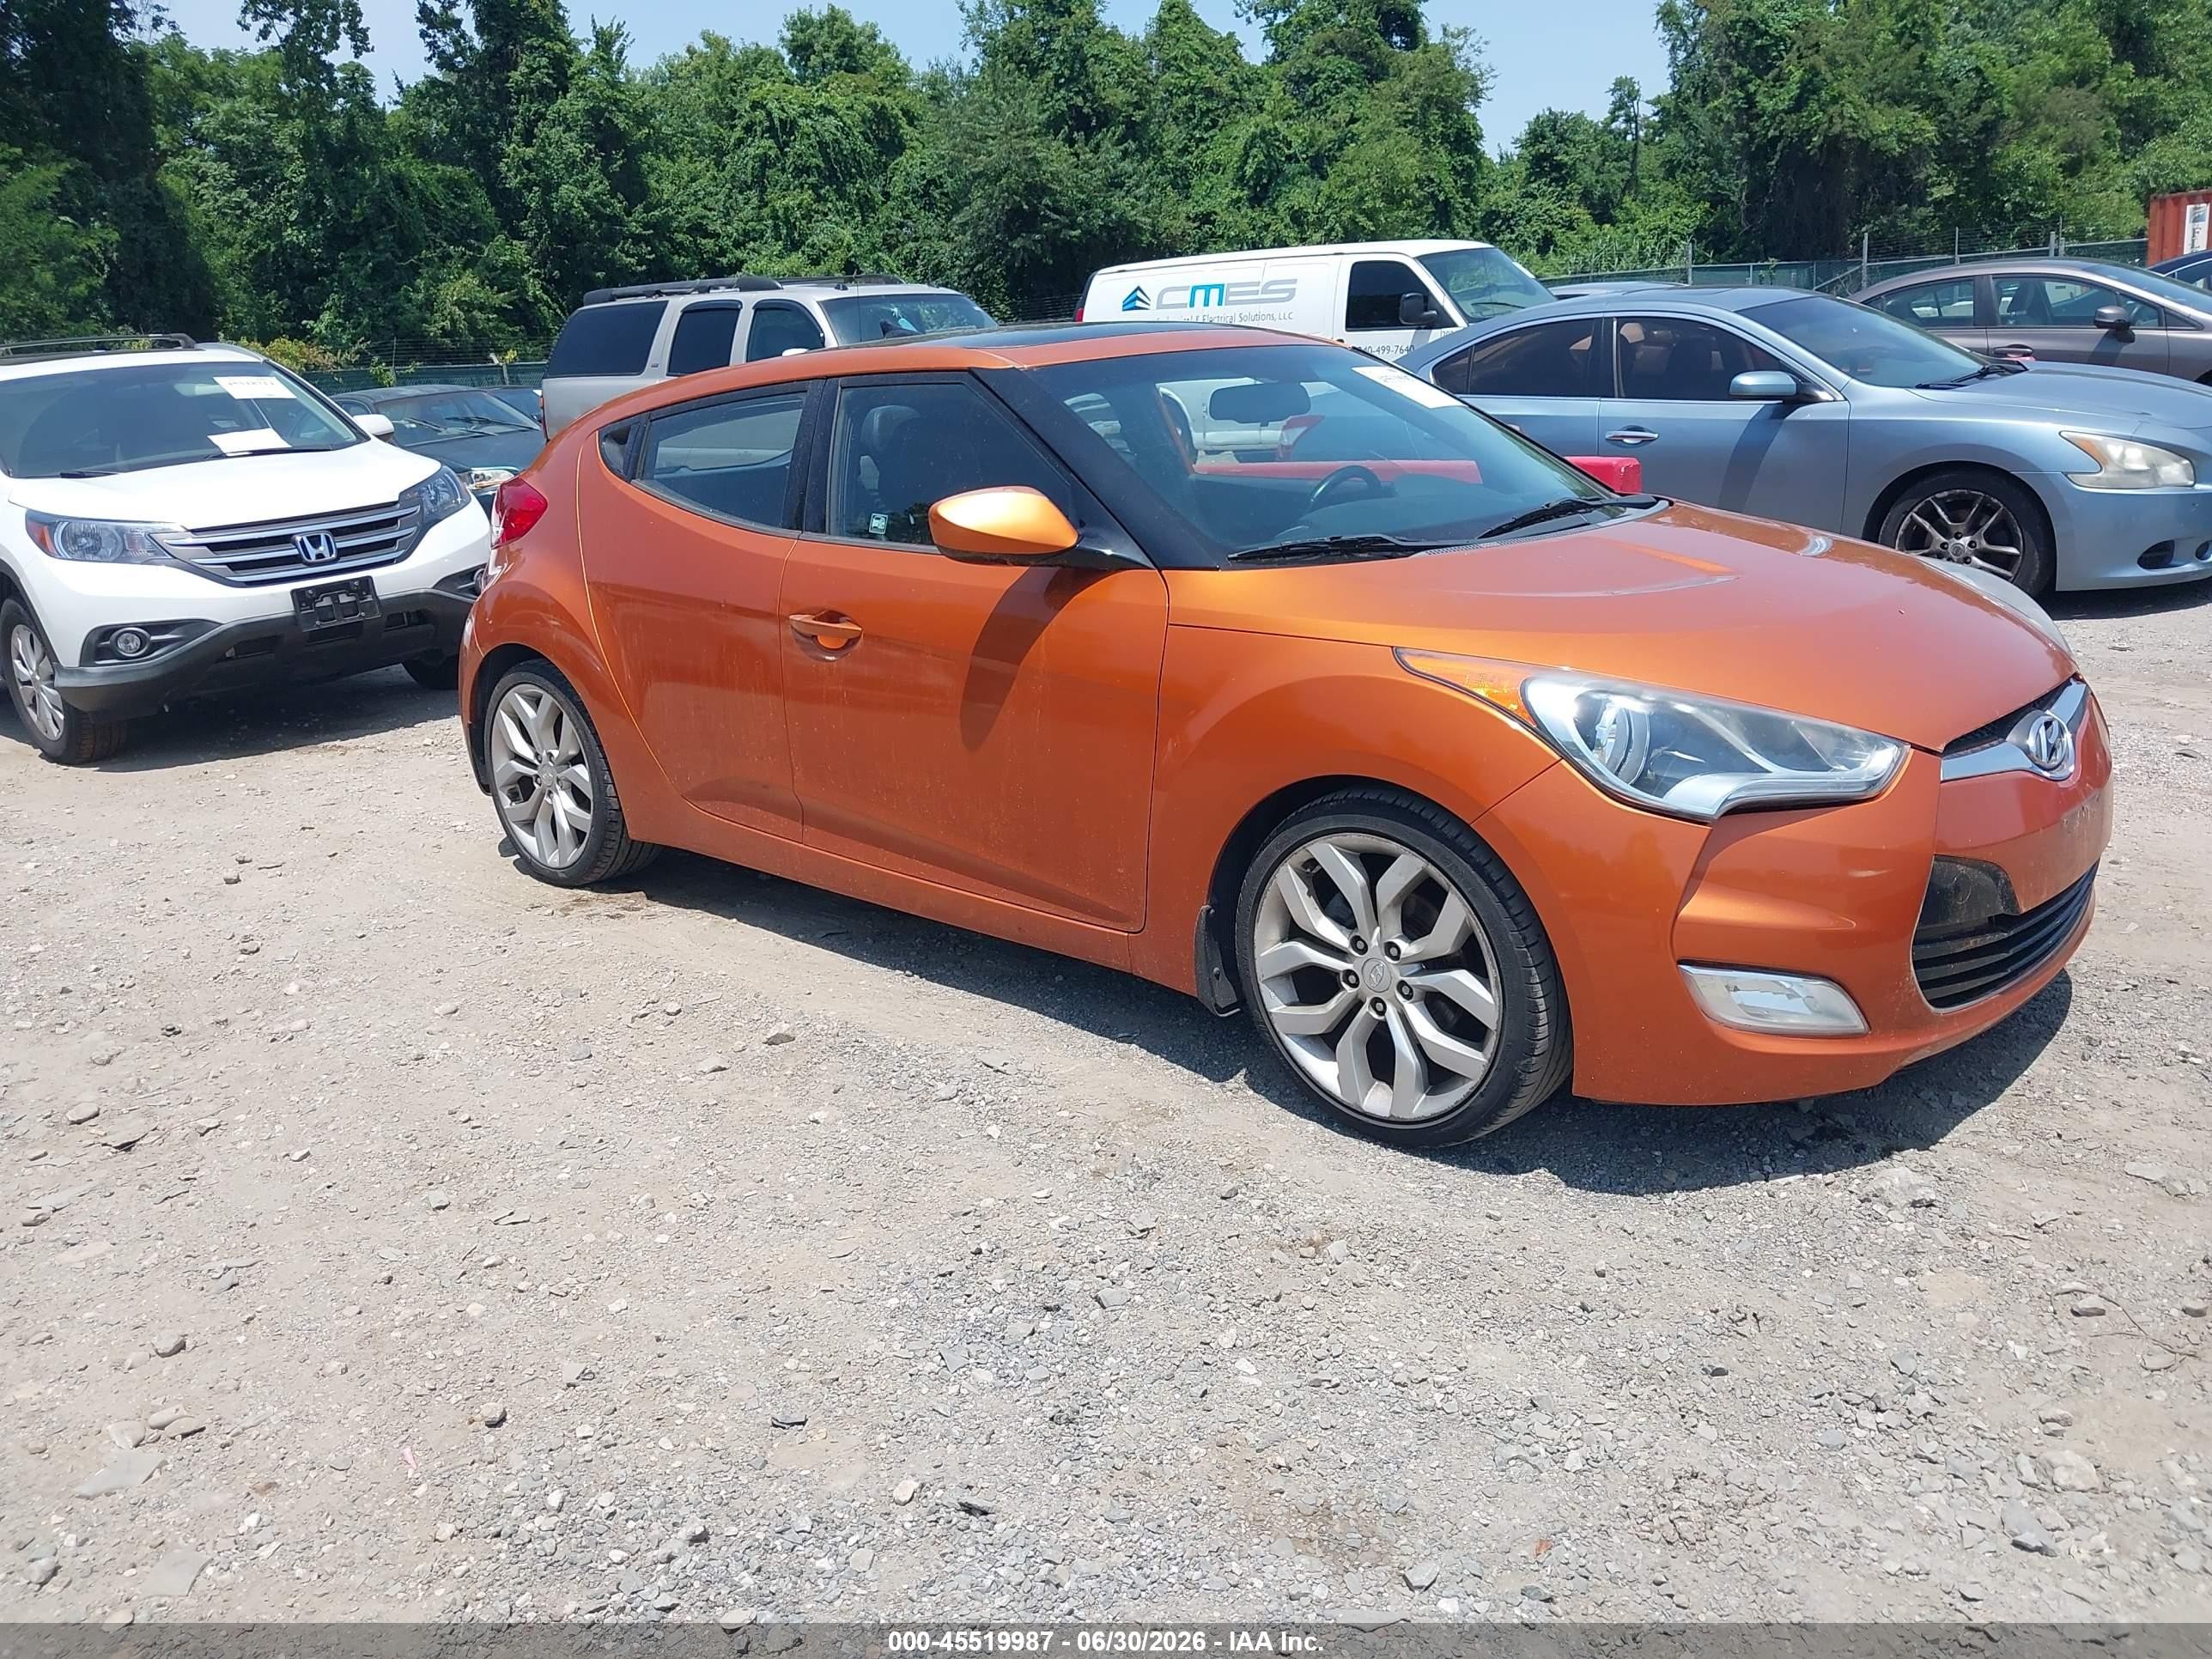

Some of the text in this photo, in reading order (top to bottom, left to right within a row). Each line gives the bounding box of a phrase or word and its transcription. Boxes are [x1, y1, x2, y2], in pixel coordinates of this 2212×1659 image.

[1156, 278, 1298, 310] CMES
[1238, 312, 1277, 323] Solutions,
[1278, 311, 1294, 321] LLC
